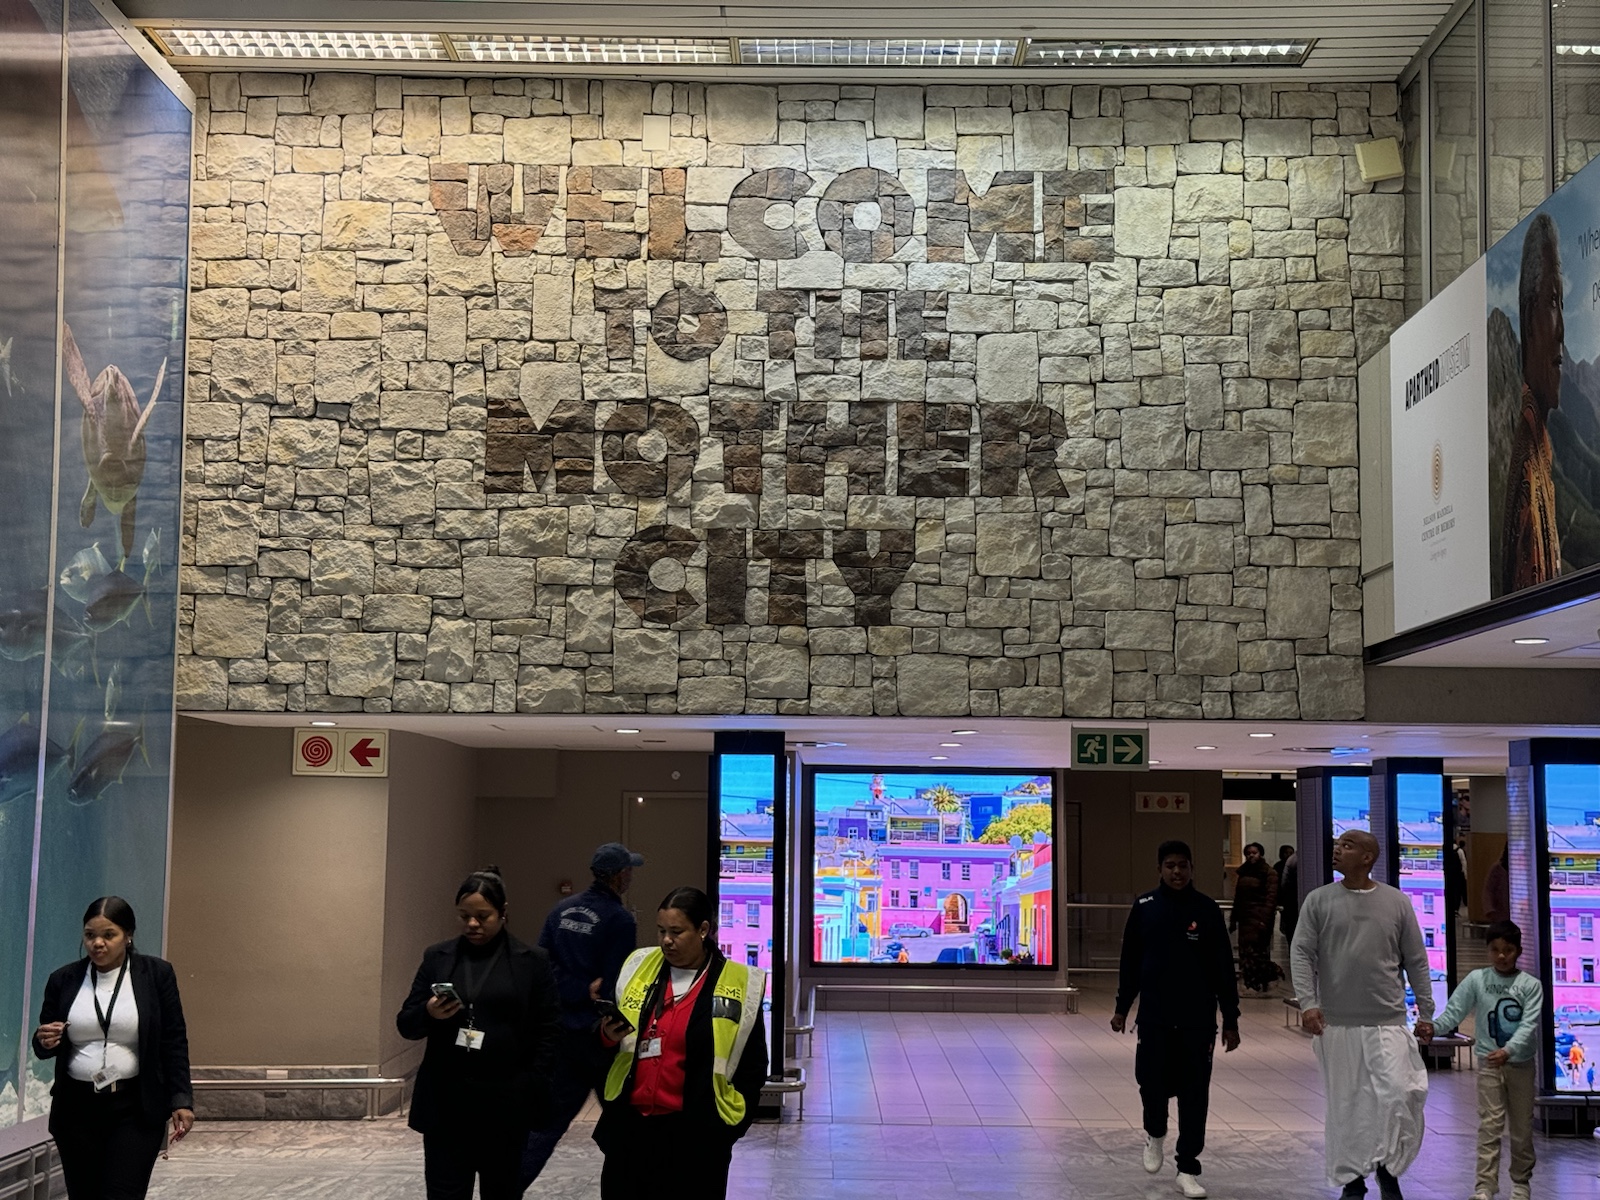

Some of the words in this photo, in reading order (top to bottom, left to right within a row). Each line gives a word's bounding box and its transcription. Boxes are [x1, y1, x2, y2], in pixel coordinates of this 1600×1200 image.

[429, 163, 1115, 263] WELCOME
[595, 287, 728, 361] TO
[757, 289, 948, 360] THE
[484, 400, 1069, 498] MOTHER
[614, 524, 914, 626] CITY
